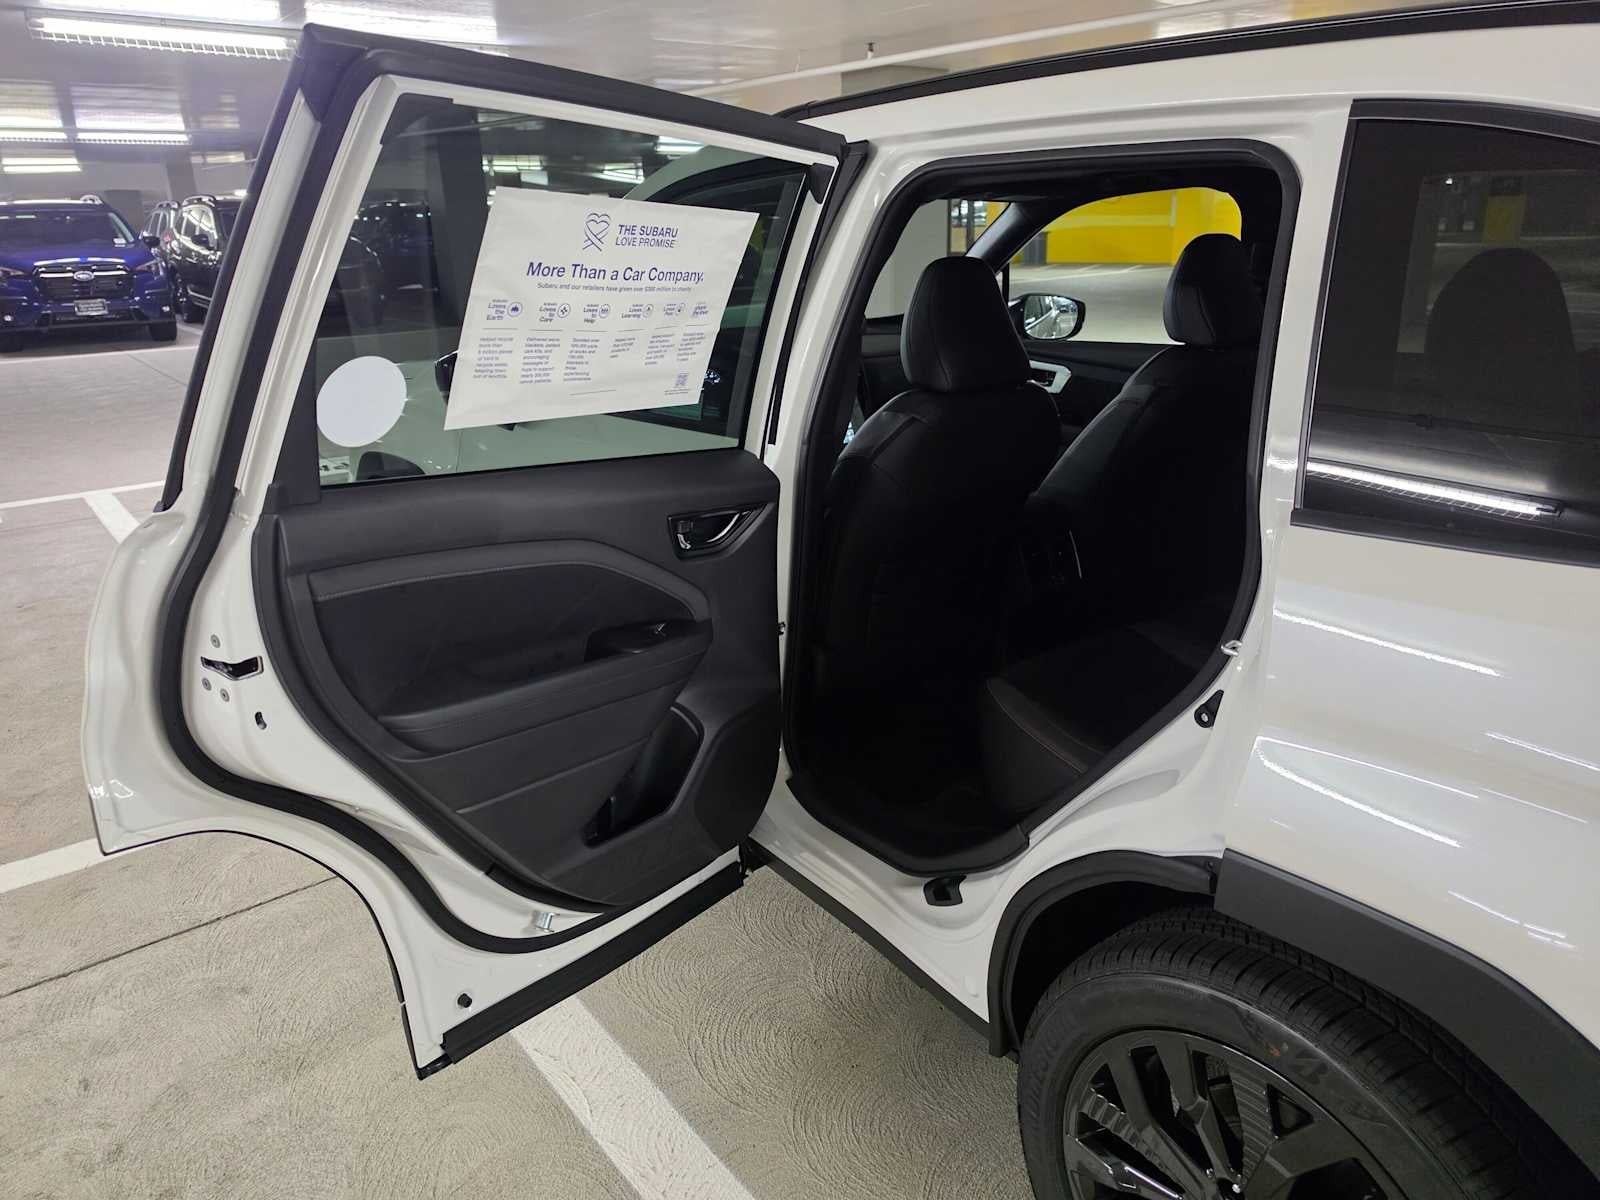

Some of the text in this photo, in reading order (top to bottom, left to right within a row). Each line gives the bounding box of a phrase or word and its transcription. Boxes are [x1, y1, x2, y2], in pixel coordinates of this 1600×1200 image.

[618, 224, 679, 238] THE SUBARU
[615, 236, 676, 249] LOVE PROMISE
[526, 261, 705, 285] More Than a Car Company.
[582, 284, 605, 292] retailers
